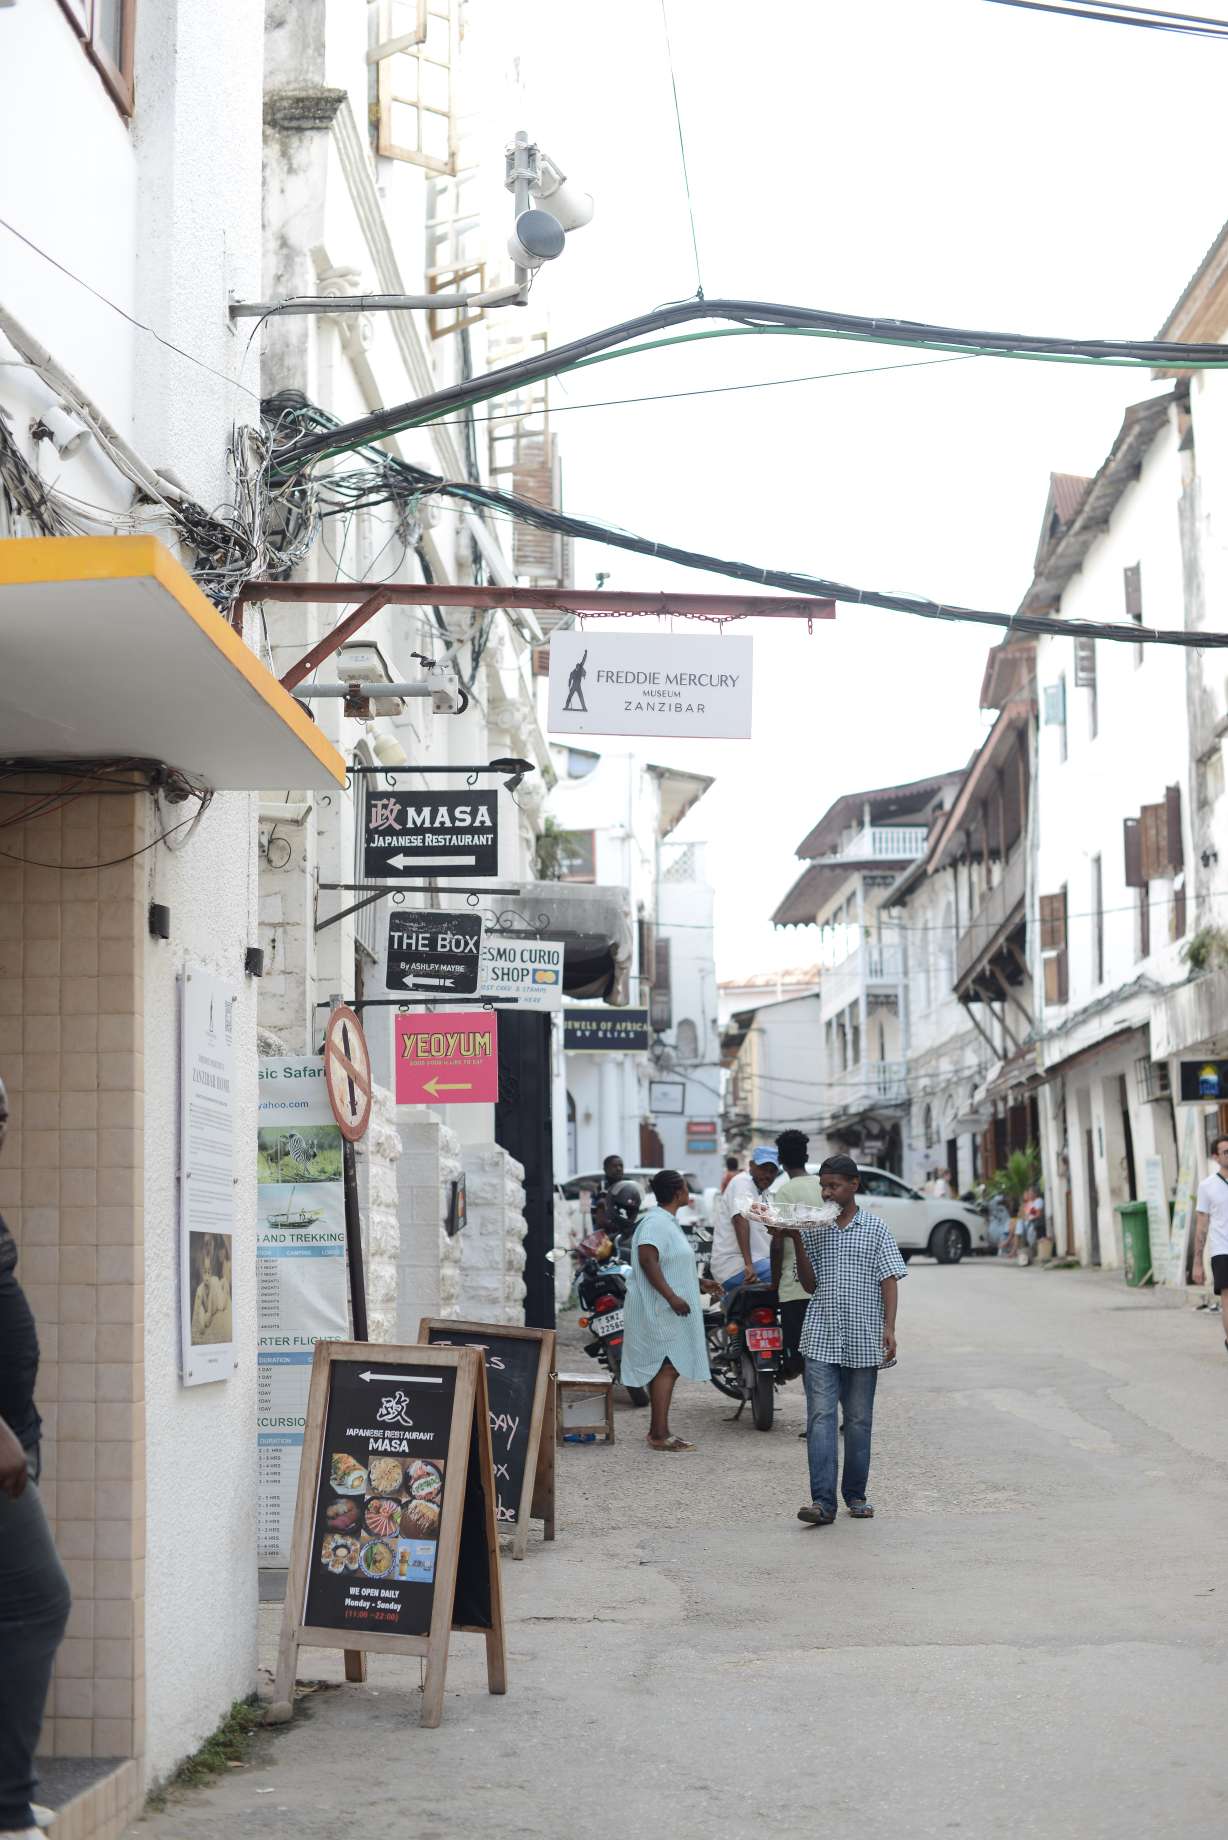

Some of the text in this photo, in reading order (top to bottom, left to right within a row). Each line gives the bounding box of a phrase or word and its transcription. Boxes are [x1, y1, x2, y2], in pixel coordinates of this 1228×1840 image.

[596, 669, 740, 688] FREDDIE MERCURY
[642, 689, 681, 698] MUSEUM
[624, 701, 705, 713] ZANZIBAR
[369, 798, 402, 830] 政
[406, 806, 493, 828] MASA
[390, 931, 479, 954] THE BOX
[520, 949, 560, 966] CURIO
[491, 966, 530, 982] SHOP
[600, 1021, 612, 1030] OF
[615, 1022, 648, 1031] AFRICA
[401, 1032, 492, 1058] YEOYUM
[263, 1232, 344, 1243] AND TREKKING
[346, 1428, 434, 1440] JAPANESE RESTAURANT
[368, 1438, 409, 1453] MASA
[349, 1587, 400, 1599] WE OPEN DAILY
[344, 1598, 371, 1609] Monday
[377, 1600, 402, 1612] Sunday
